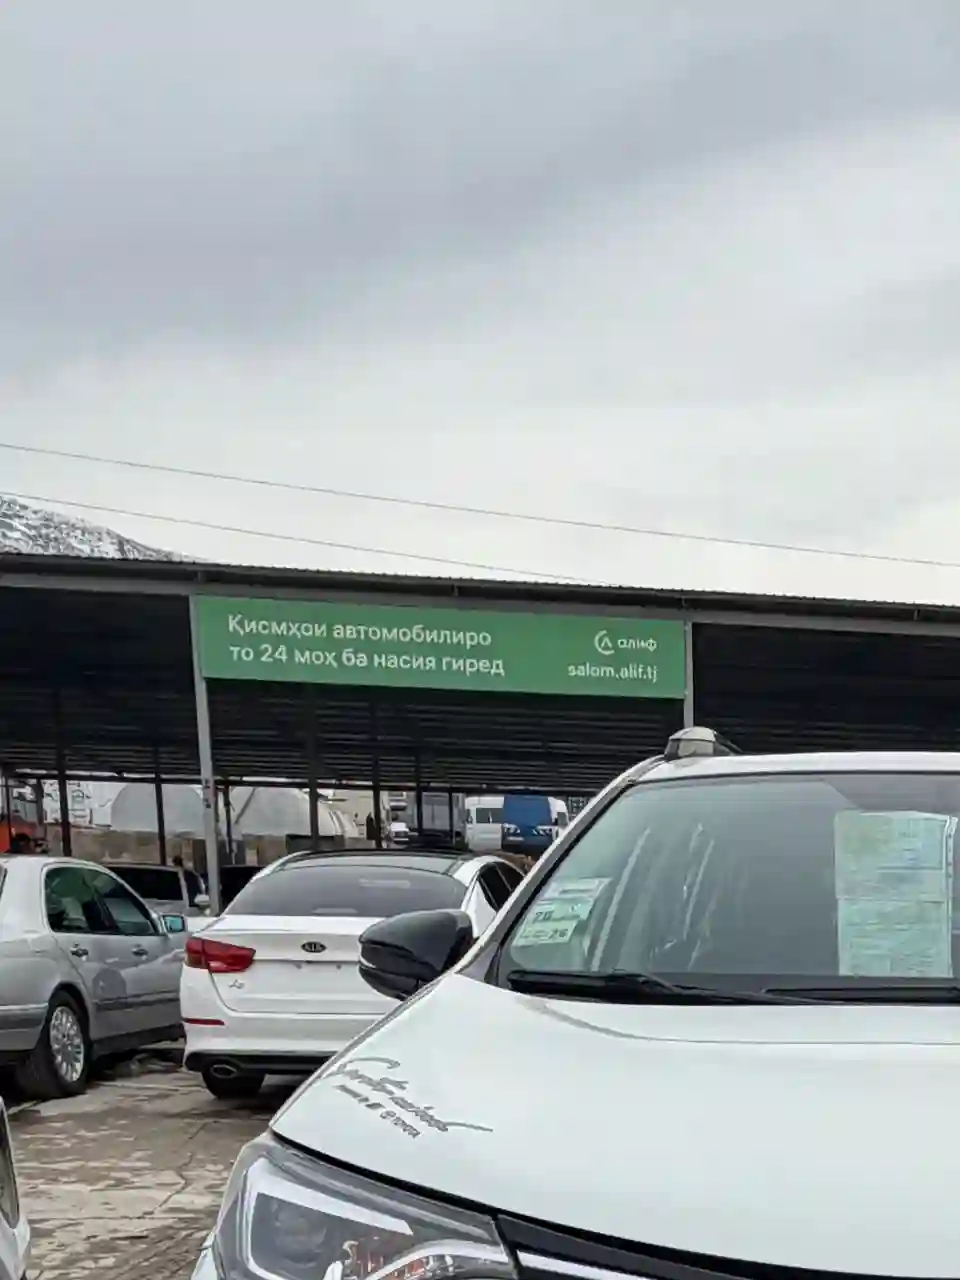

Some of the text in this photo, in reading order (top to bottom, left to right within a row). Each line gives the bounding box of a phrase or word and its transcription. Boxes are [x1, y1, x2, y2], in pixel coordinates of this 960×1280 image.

[228, 613, 492, 650] Қисмҳои автомобилиро
[617, 637, 657, 652] алиф
[229, 643, 505, 677] то 24 моҳ ба насия гиред
[567, 661, 658, 684] salom.alif.tj
